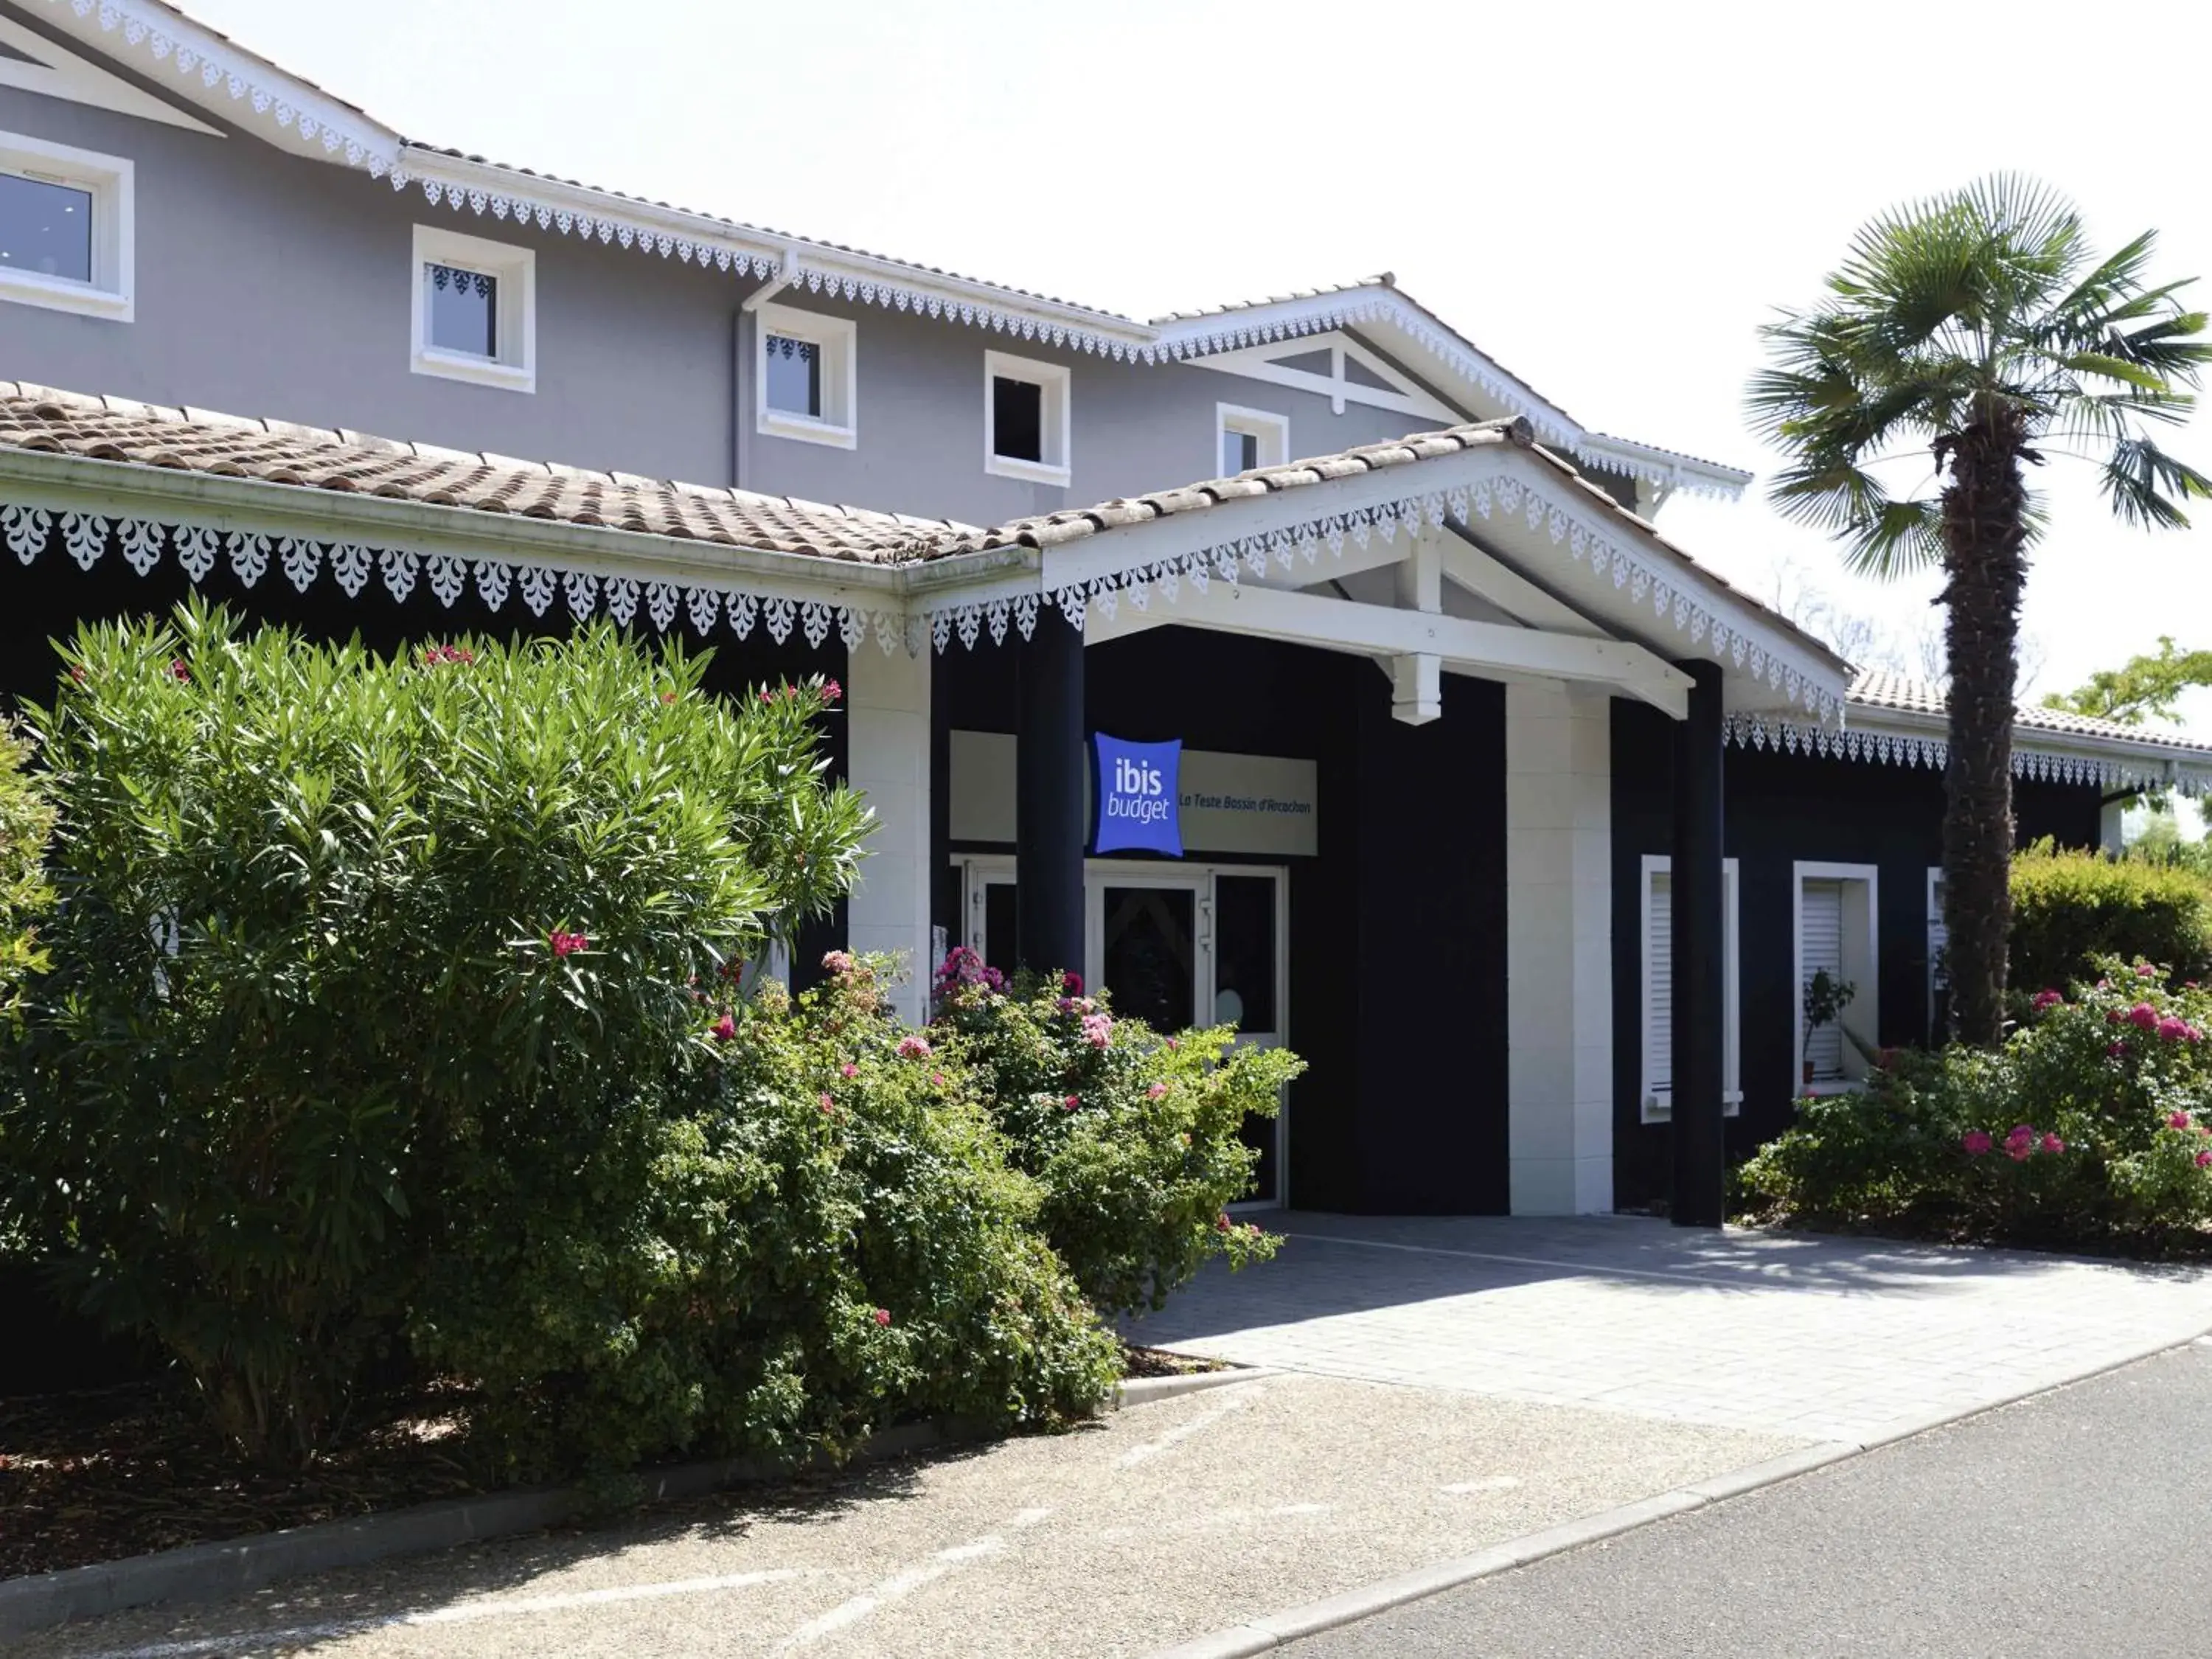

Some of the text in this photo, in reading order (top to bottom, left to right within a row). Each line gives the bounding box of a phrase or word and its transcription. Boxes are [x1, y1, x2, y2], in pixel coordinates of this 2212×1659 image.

[1116, 757, 1162, 796] ibis
[1108, 792, 1169, 824] budget
[1179, 793, 1191, 807] La
[1194, 793, 1221, 808] Teste
[1224, 796, 1256, 810] Bassin
